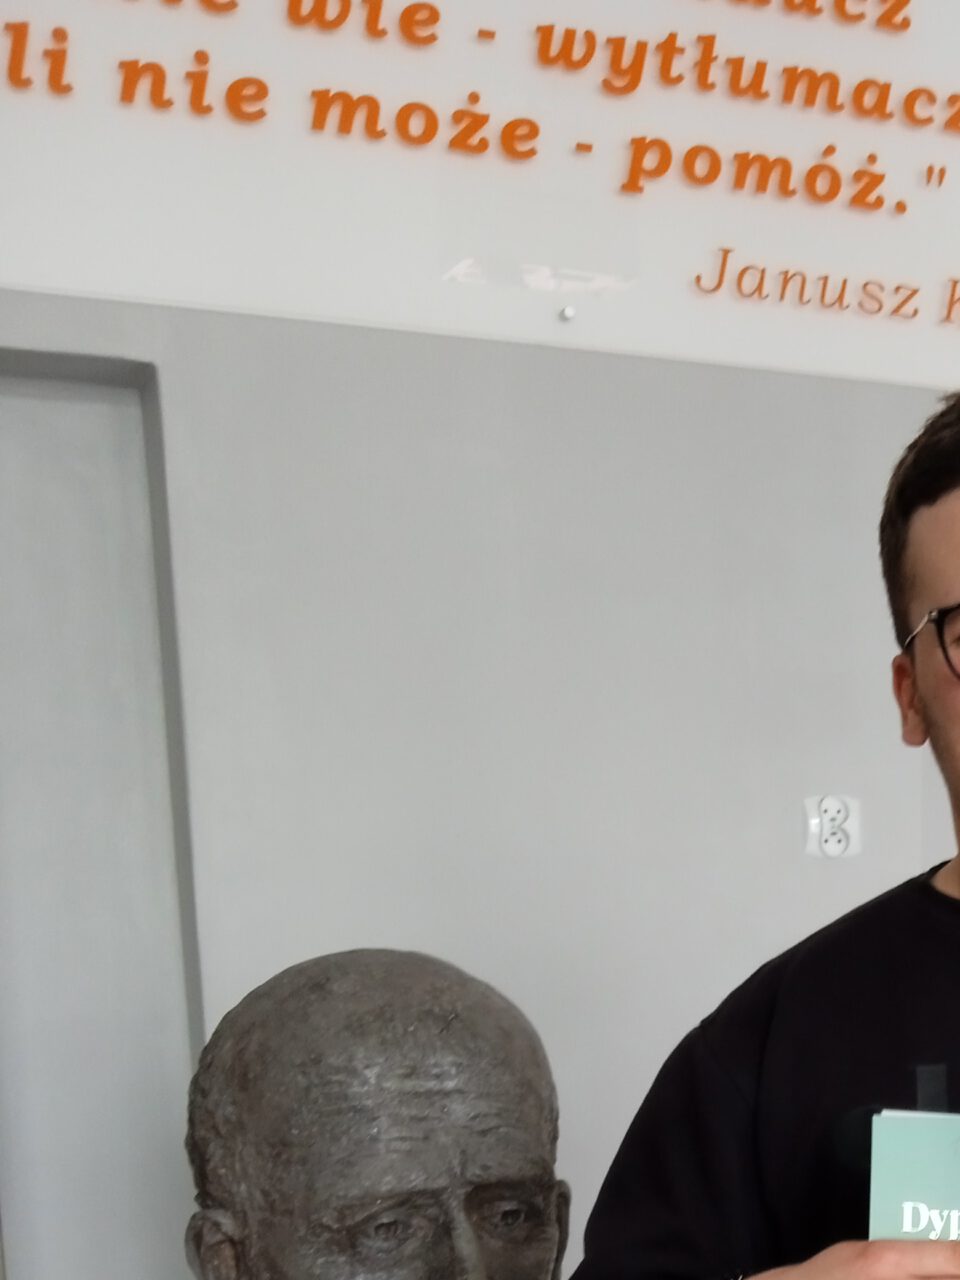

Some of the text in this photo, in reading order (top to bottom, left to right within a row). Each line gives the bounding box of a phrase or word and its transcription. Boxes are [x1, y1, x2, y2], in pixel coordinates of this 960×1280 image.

[118, 49, 271, 122] nie
[310, 88, 540, 160] może
[619, 135, 947, 215] pomóż."
[694, 246, 921, 320] Janusz
